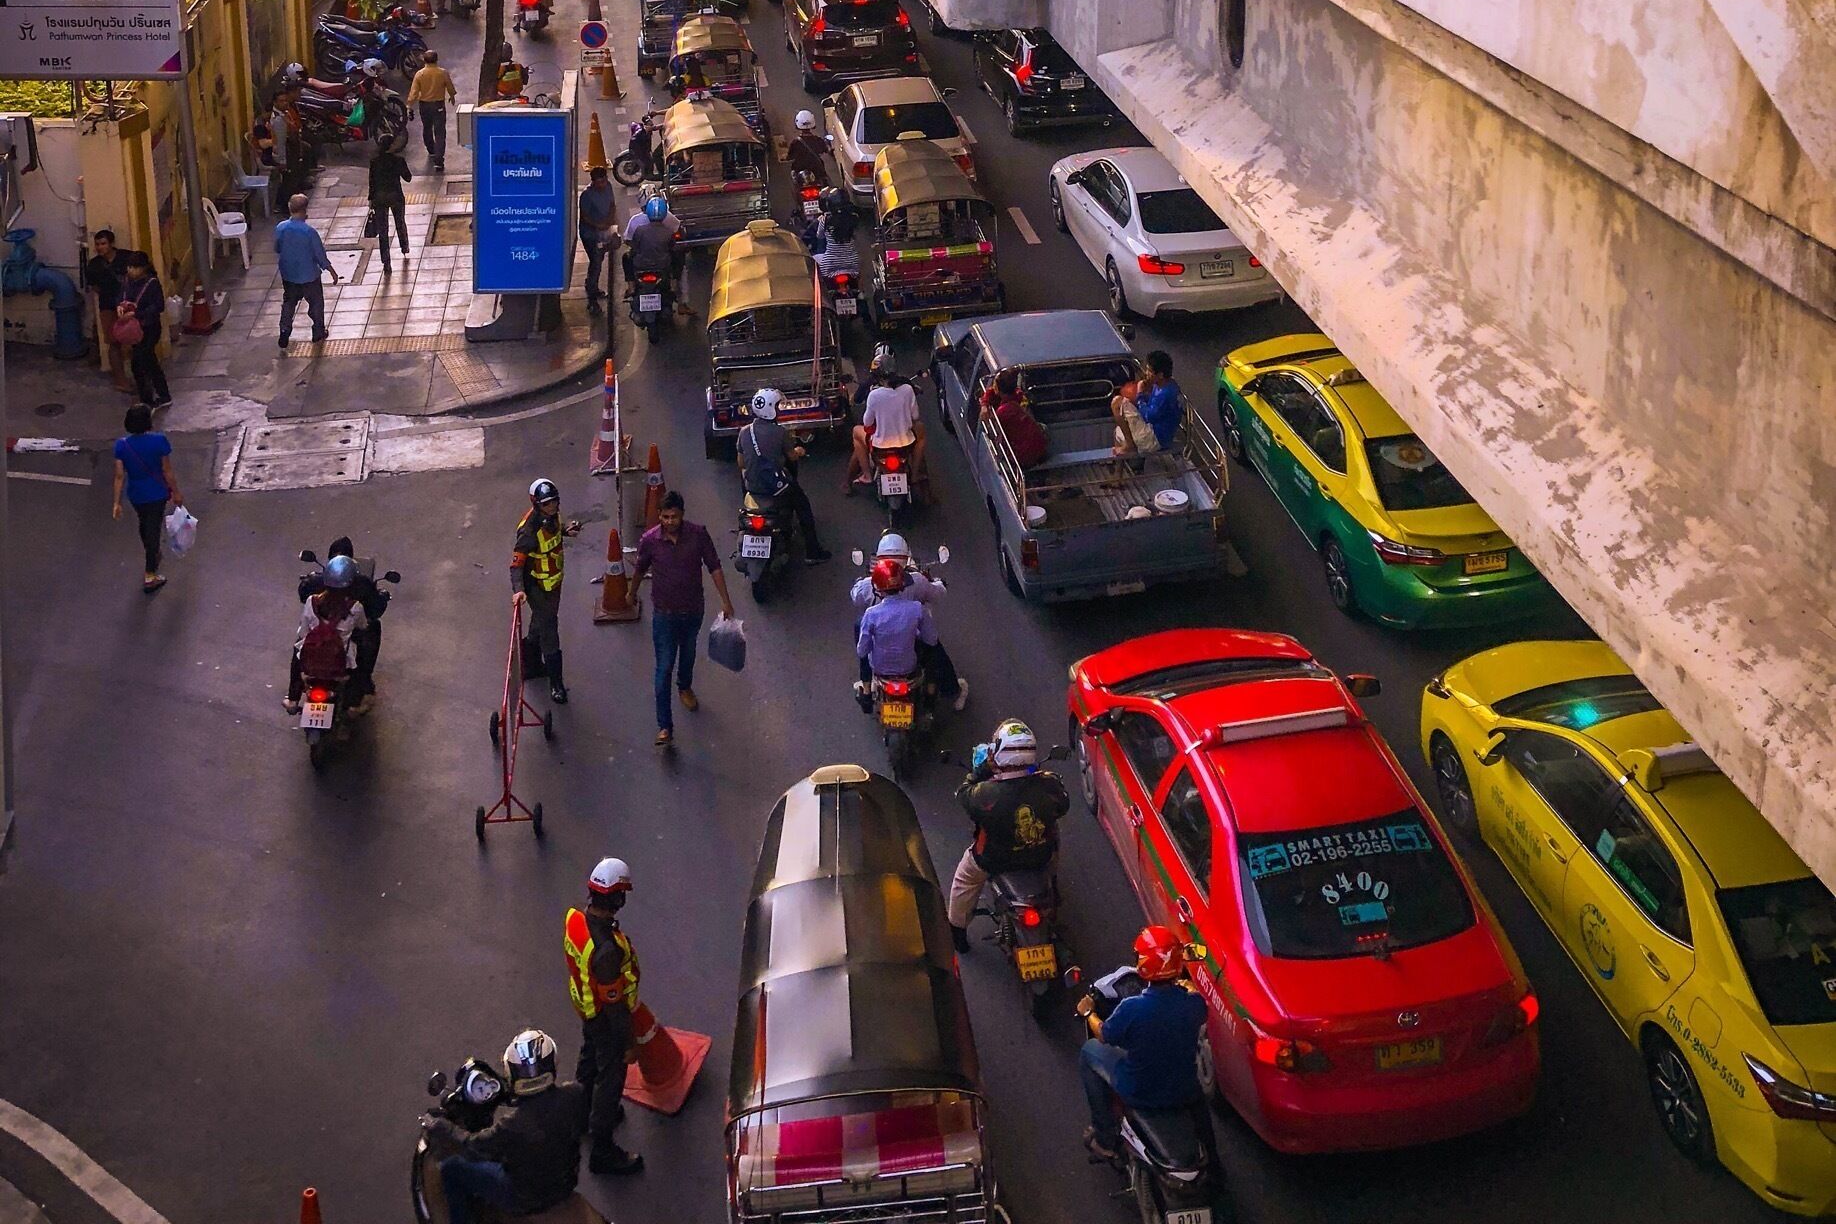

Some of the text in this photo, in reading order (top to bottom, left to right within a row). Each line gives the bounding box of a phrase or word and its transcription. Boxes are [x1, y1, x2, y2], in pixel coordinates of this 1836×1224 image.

[49, 31, 171, 41] Pathumwan Princess Hotel
[39, 56, 72, 66] MBK
[511, 250, 536, 261] 1484
[1286, 827, 1388, 854] SMART TAXI
[1291, 839, 1393, 867] 02-196-2255
[1321, 871, 1390, 905] 8400
